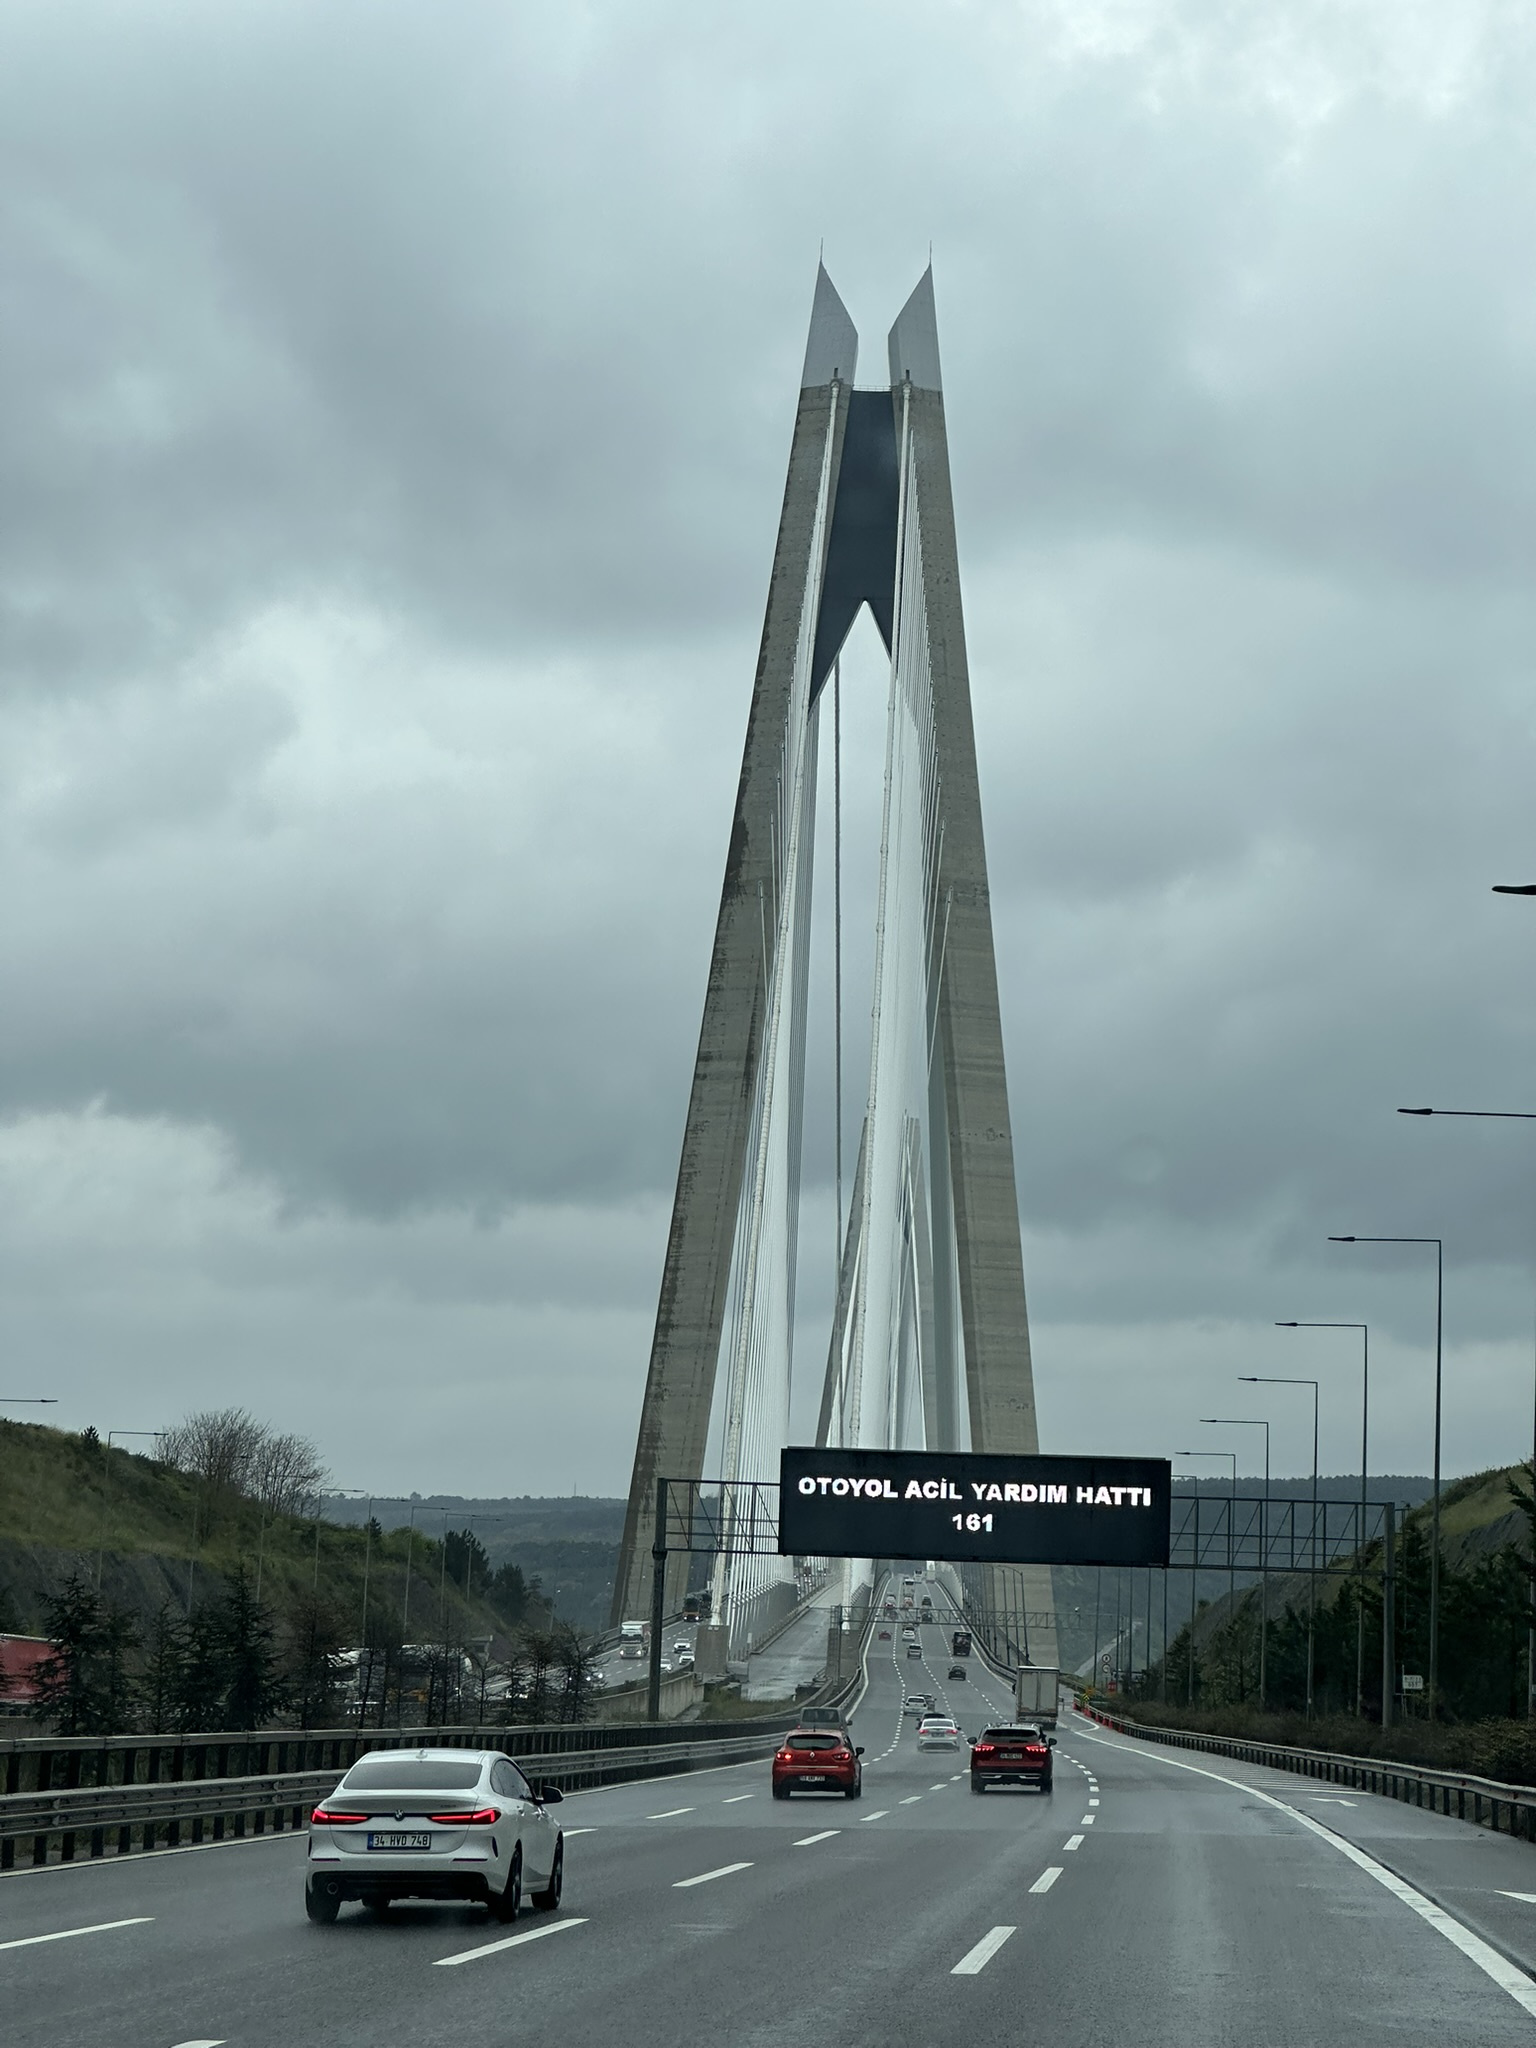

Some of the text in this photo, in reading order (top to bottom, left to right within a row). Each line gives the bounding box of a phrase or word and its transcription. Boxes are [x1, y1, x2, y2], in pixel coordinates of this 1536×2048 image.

[798, 1476, 1152, 1507] OTOYOL ACİL YARDIM HATTI
[952, 1512, 993, 1533] 161
[374, 1835, 385, 1846] 34
[411, 1835, 428, 1846] 748
